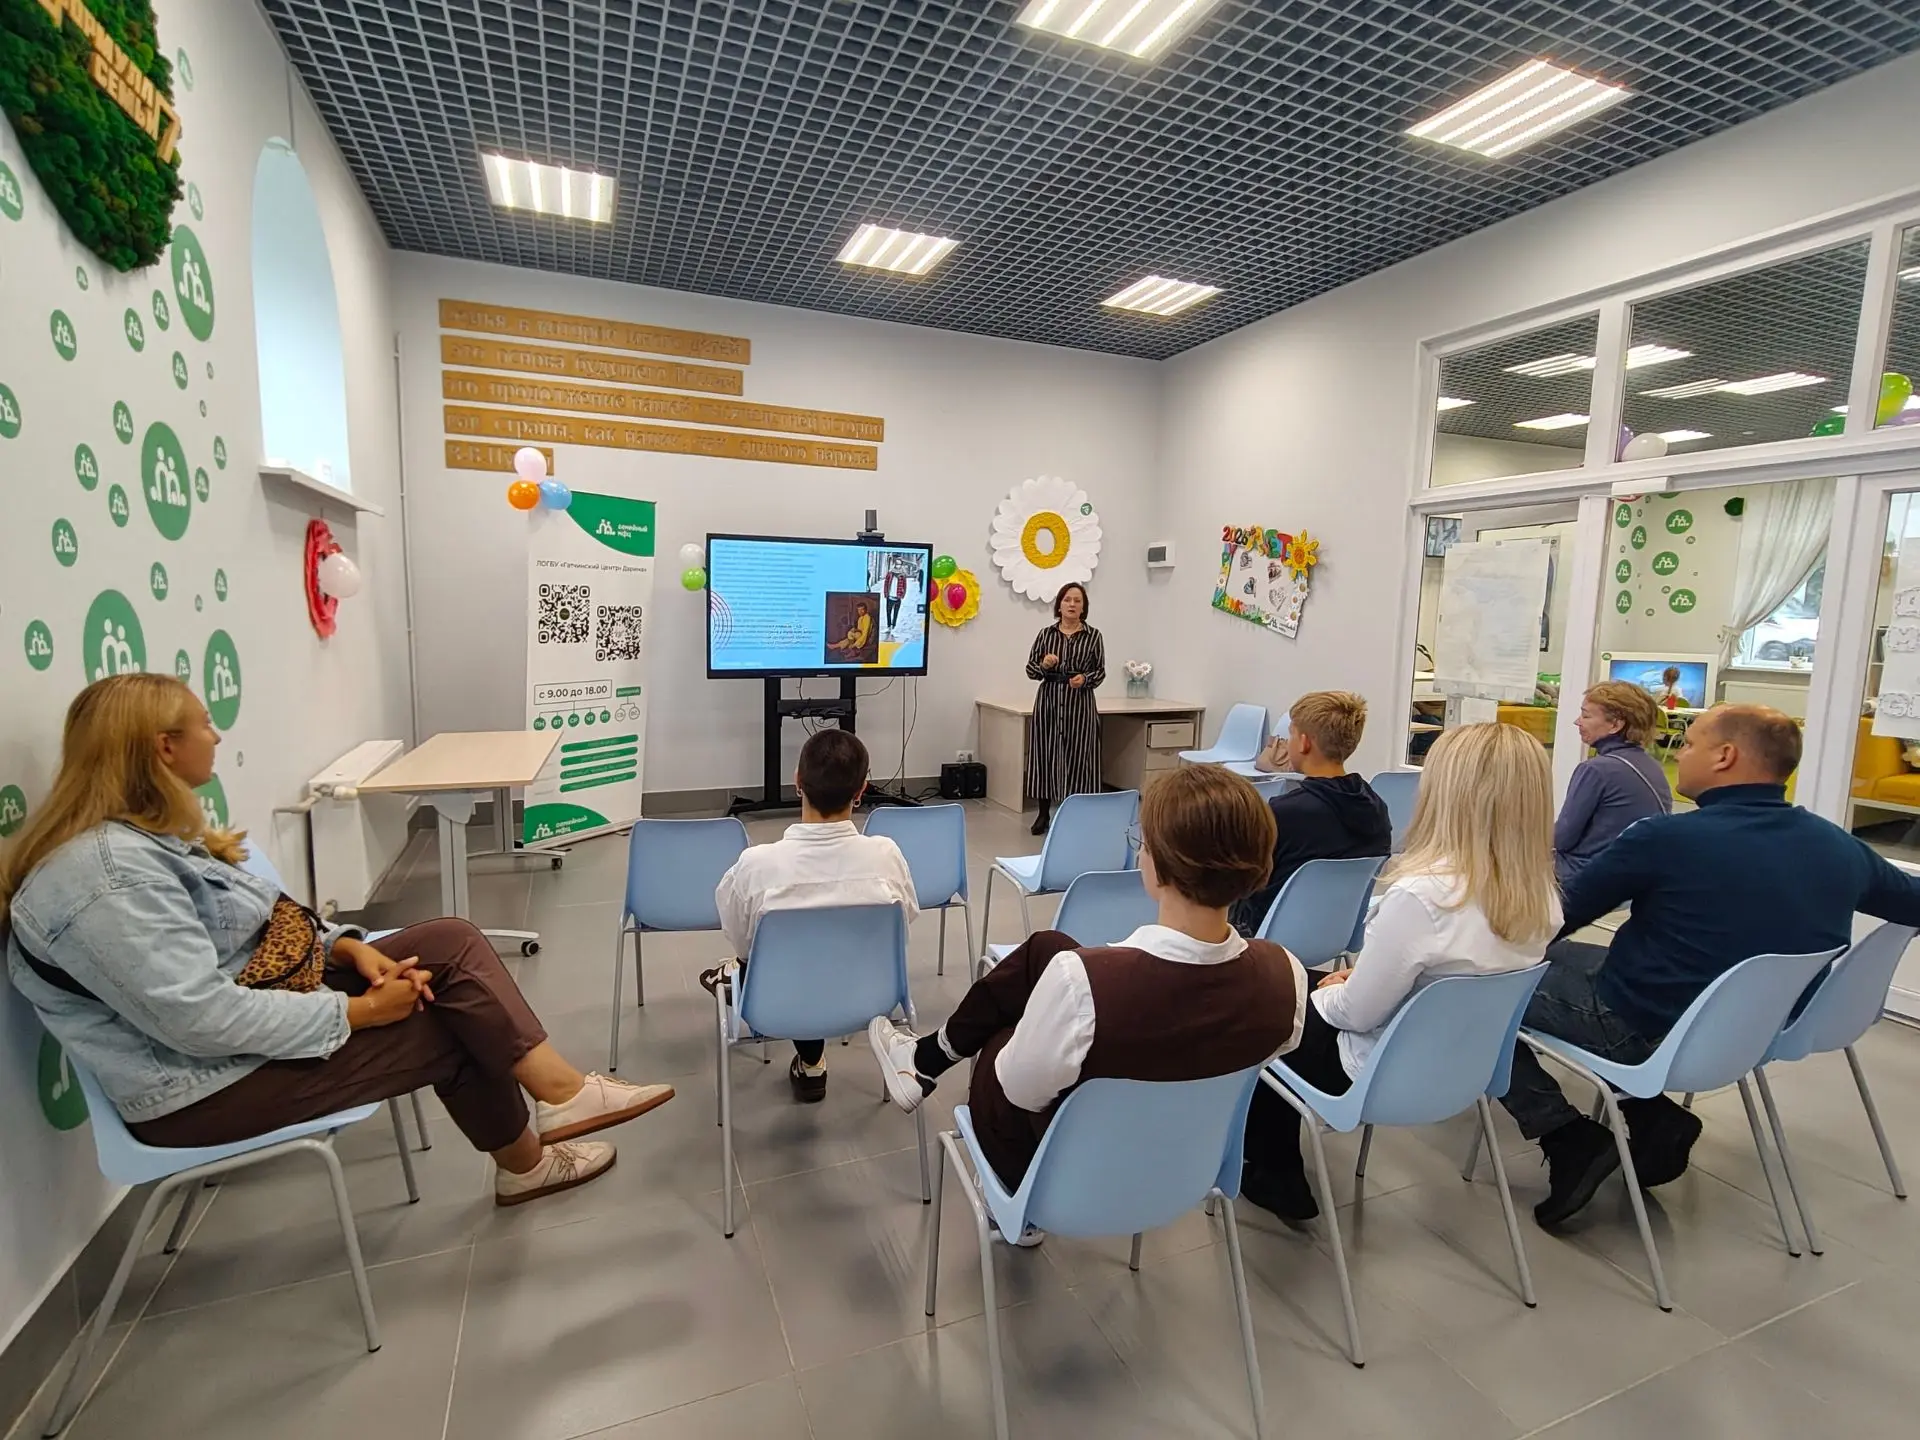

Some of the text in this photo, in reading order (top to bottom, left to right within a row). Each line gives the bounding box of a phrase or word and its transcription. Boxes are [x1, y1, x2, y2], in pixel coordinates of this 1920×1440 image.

[91, 51, 161, 141] СЕМЬИ
[488, 380, 625, 411] продолжение
[584, 425, 616, 442] как
[547, 688, 568, 699] 9.00
[570, 690, 583, 698] до
[585, 685, 608, 695] 18.00
